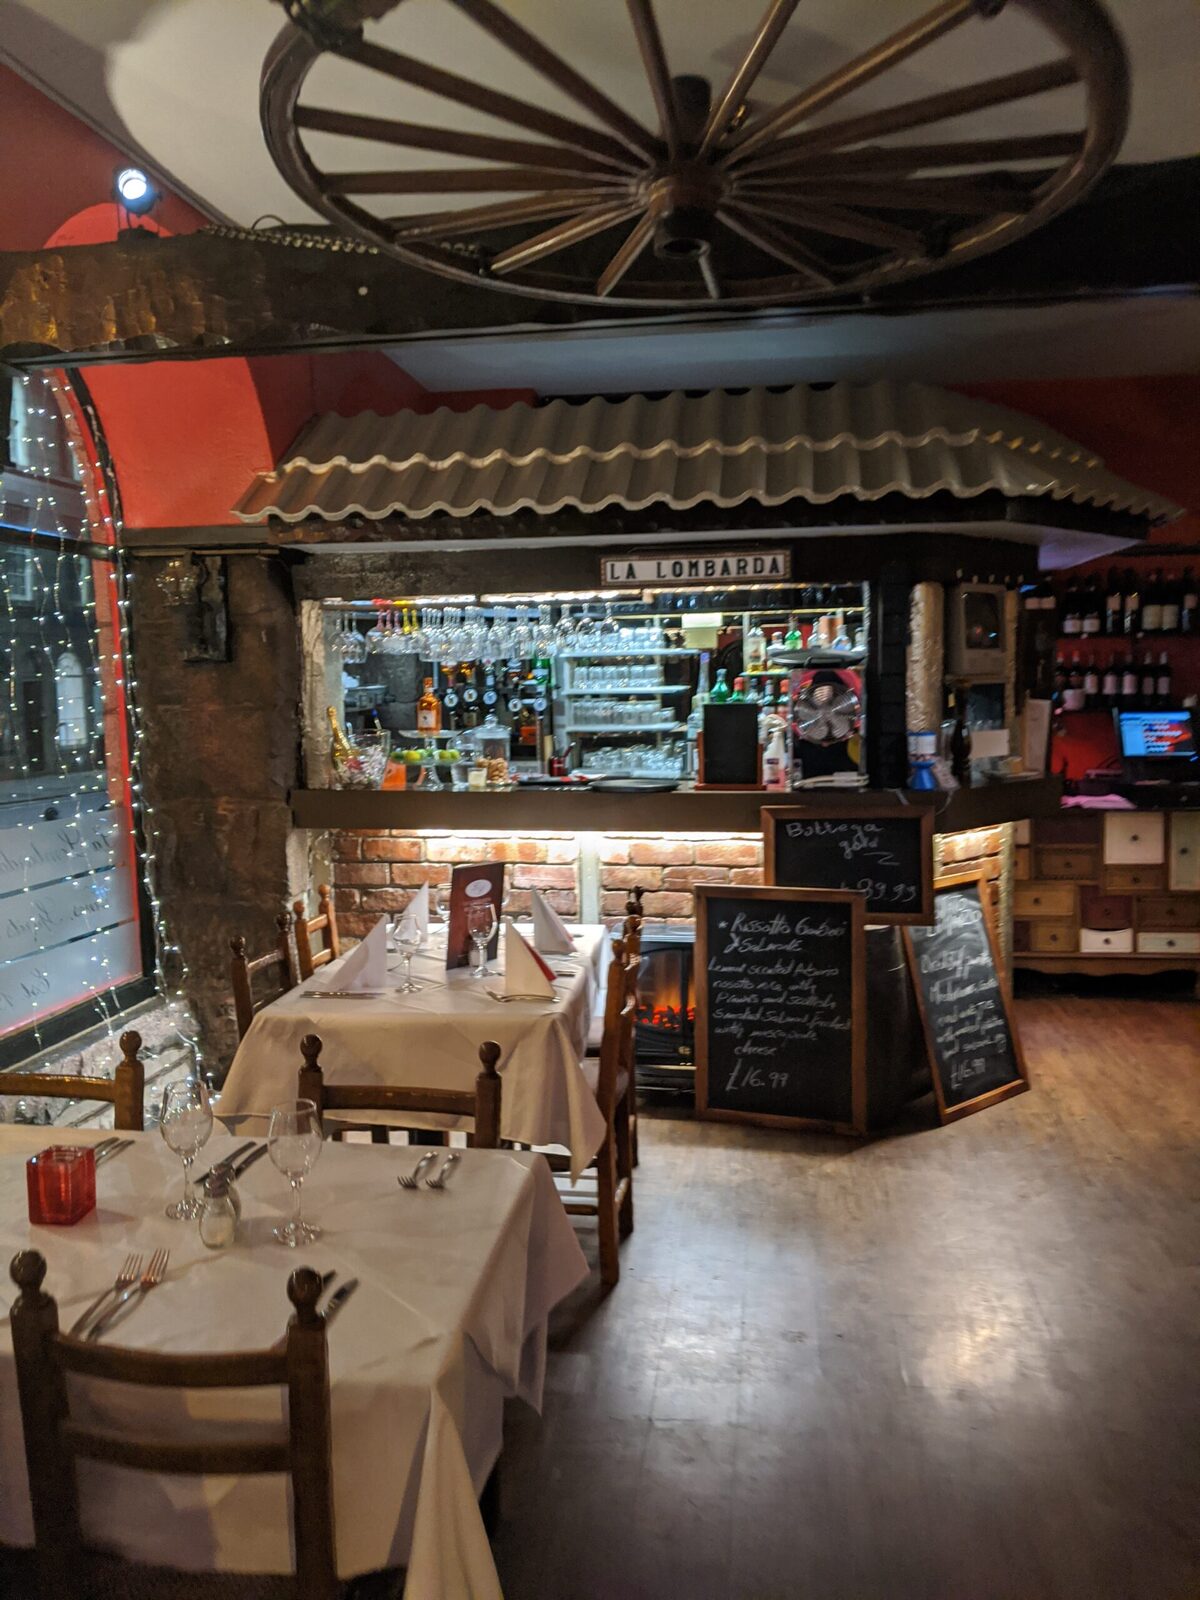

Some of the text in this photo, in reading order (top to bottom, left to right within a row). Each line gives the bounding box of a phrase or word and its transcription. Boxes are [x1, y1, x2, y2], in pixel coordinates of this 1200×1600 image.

[610, 556, 781, 580] LA LOMBARDA
[724, 1058, 790, 1092] £16.99
